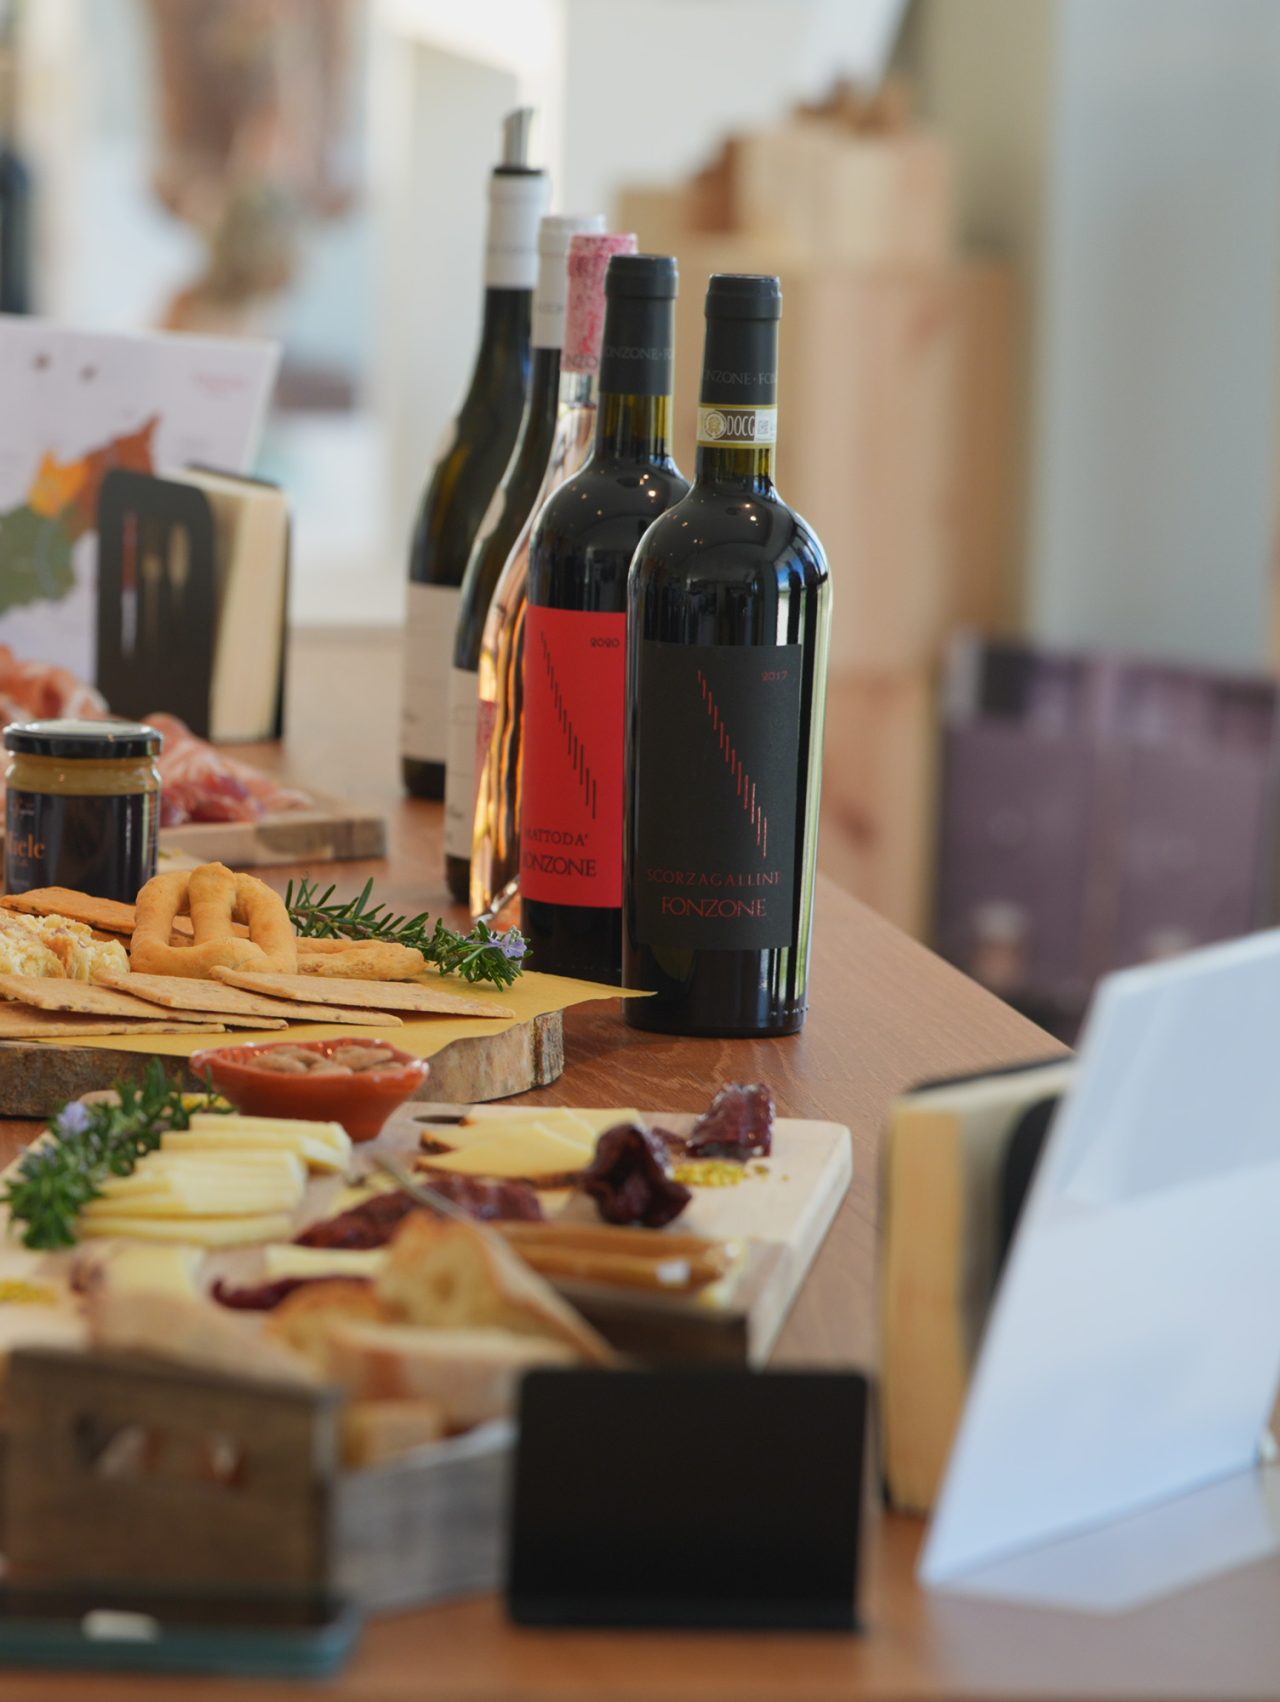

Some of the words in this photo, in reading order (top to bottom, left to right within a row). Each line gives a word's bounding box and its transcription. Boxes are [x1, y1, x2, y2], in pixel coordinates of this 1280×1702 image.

[761, 670, 788, 682] 2017
[523, 850, 597, 878] ONZONE
[661, 896, 767, 918] FONZONE
